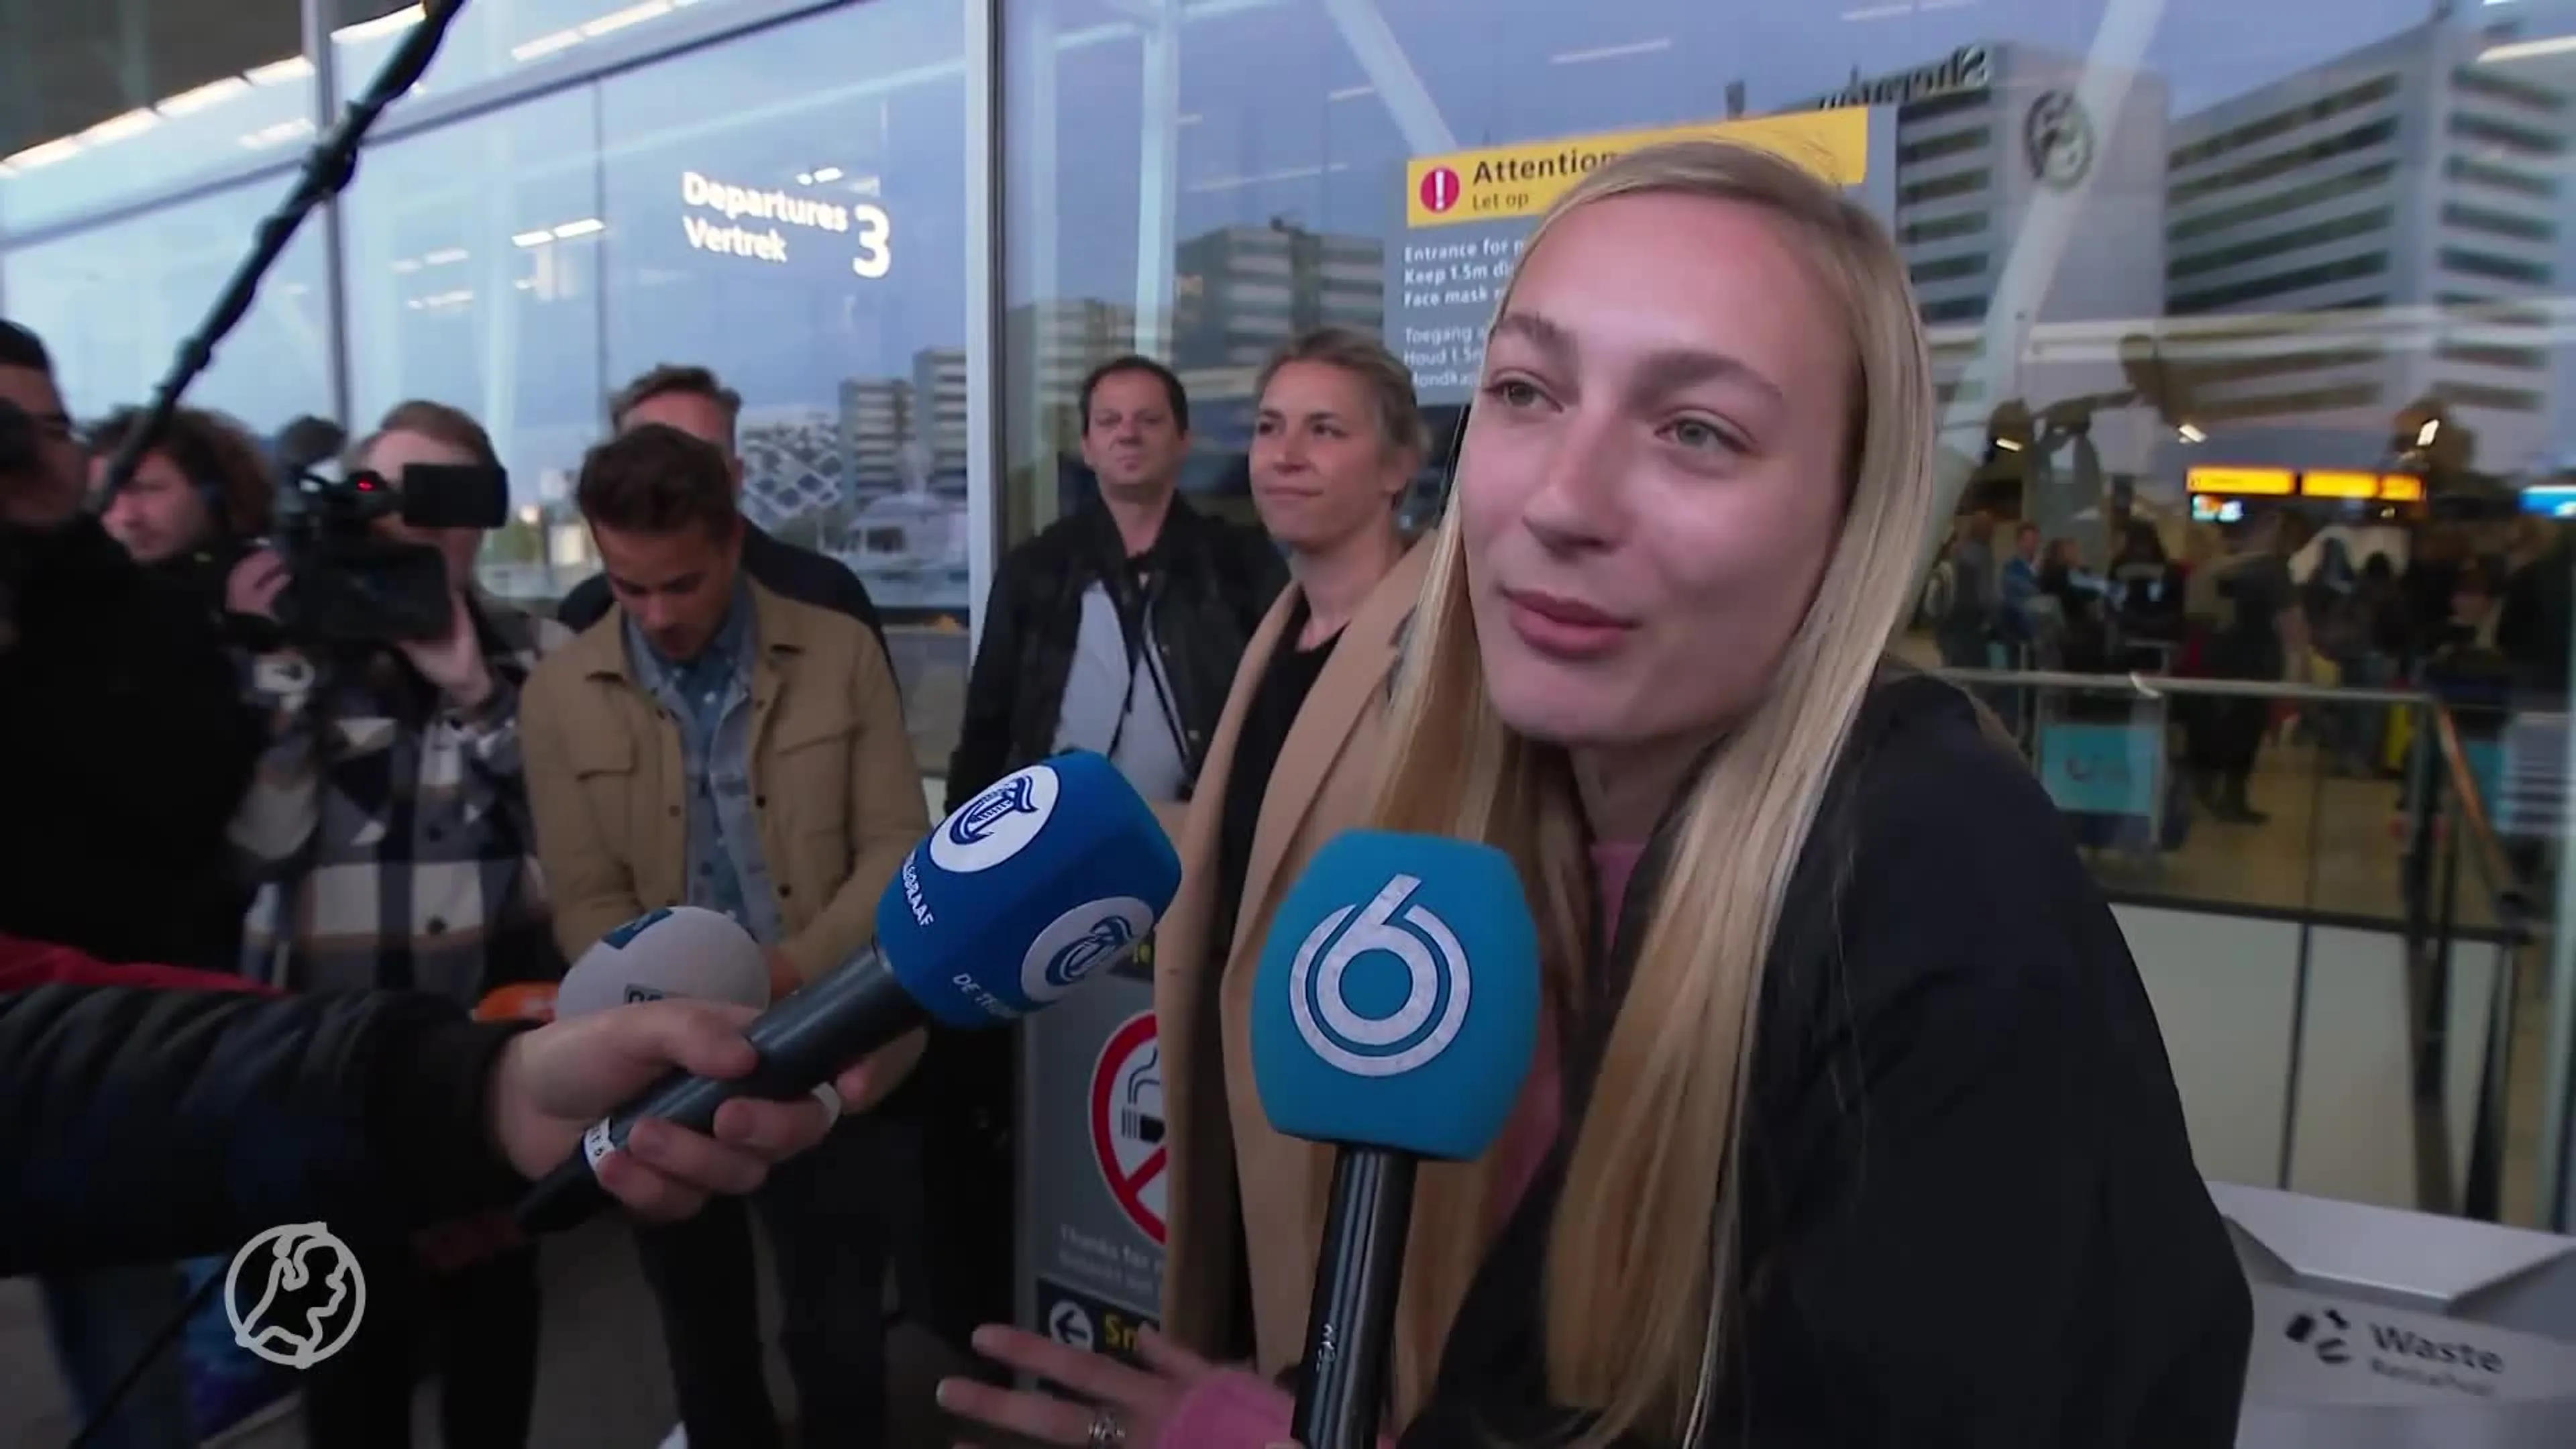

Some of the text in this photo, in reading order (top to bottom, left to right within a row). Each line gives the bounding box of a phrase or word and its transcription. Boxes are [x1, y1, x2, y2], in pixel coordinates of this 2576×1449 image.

[683, 171, 848, 232] Departures
[1472, 194, 1529, 211] Let op
[683, 215, 788, 263] Vertrek
[852, 204, 891, 278] 3
[1405, 243, 1477, 263] Entrance
[1483, 237, 1508, 256] for
[1405, 266, 1446, 285] Keep
[1405, 288, 1440, 308] Face
[1445, 284, 1487, 305] mask
[1406, 327, 1472, 345] Toegang
[1404, 348, 1447, 366] Houd
[1289, 873, 1473, 1077] 6
[2369, 1322, 2504, 1374] Waste
